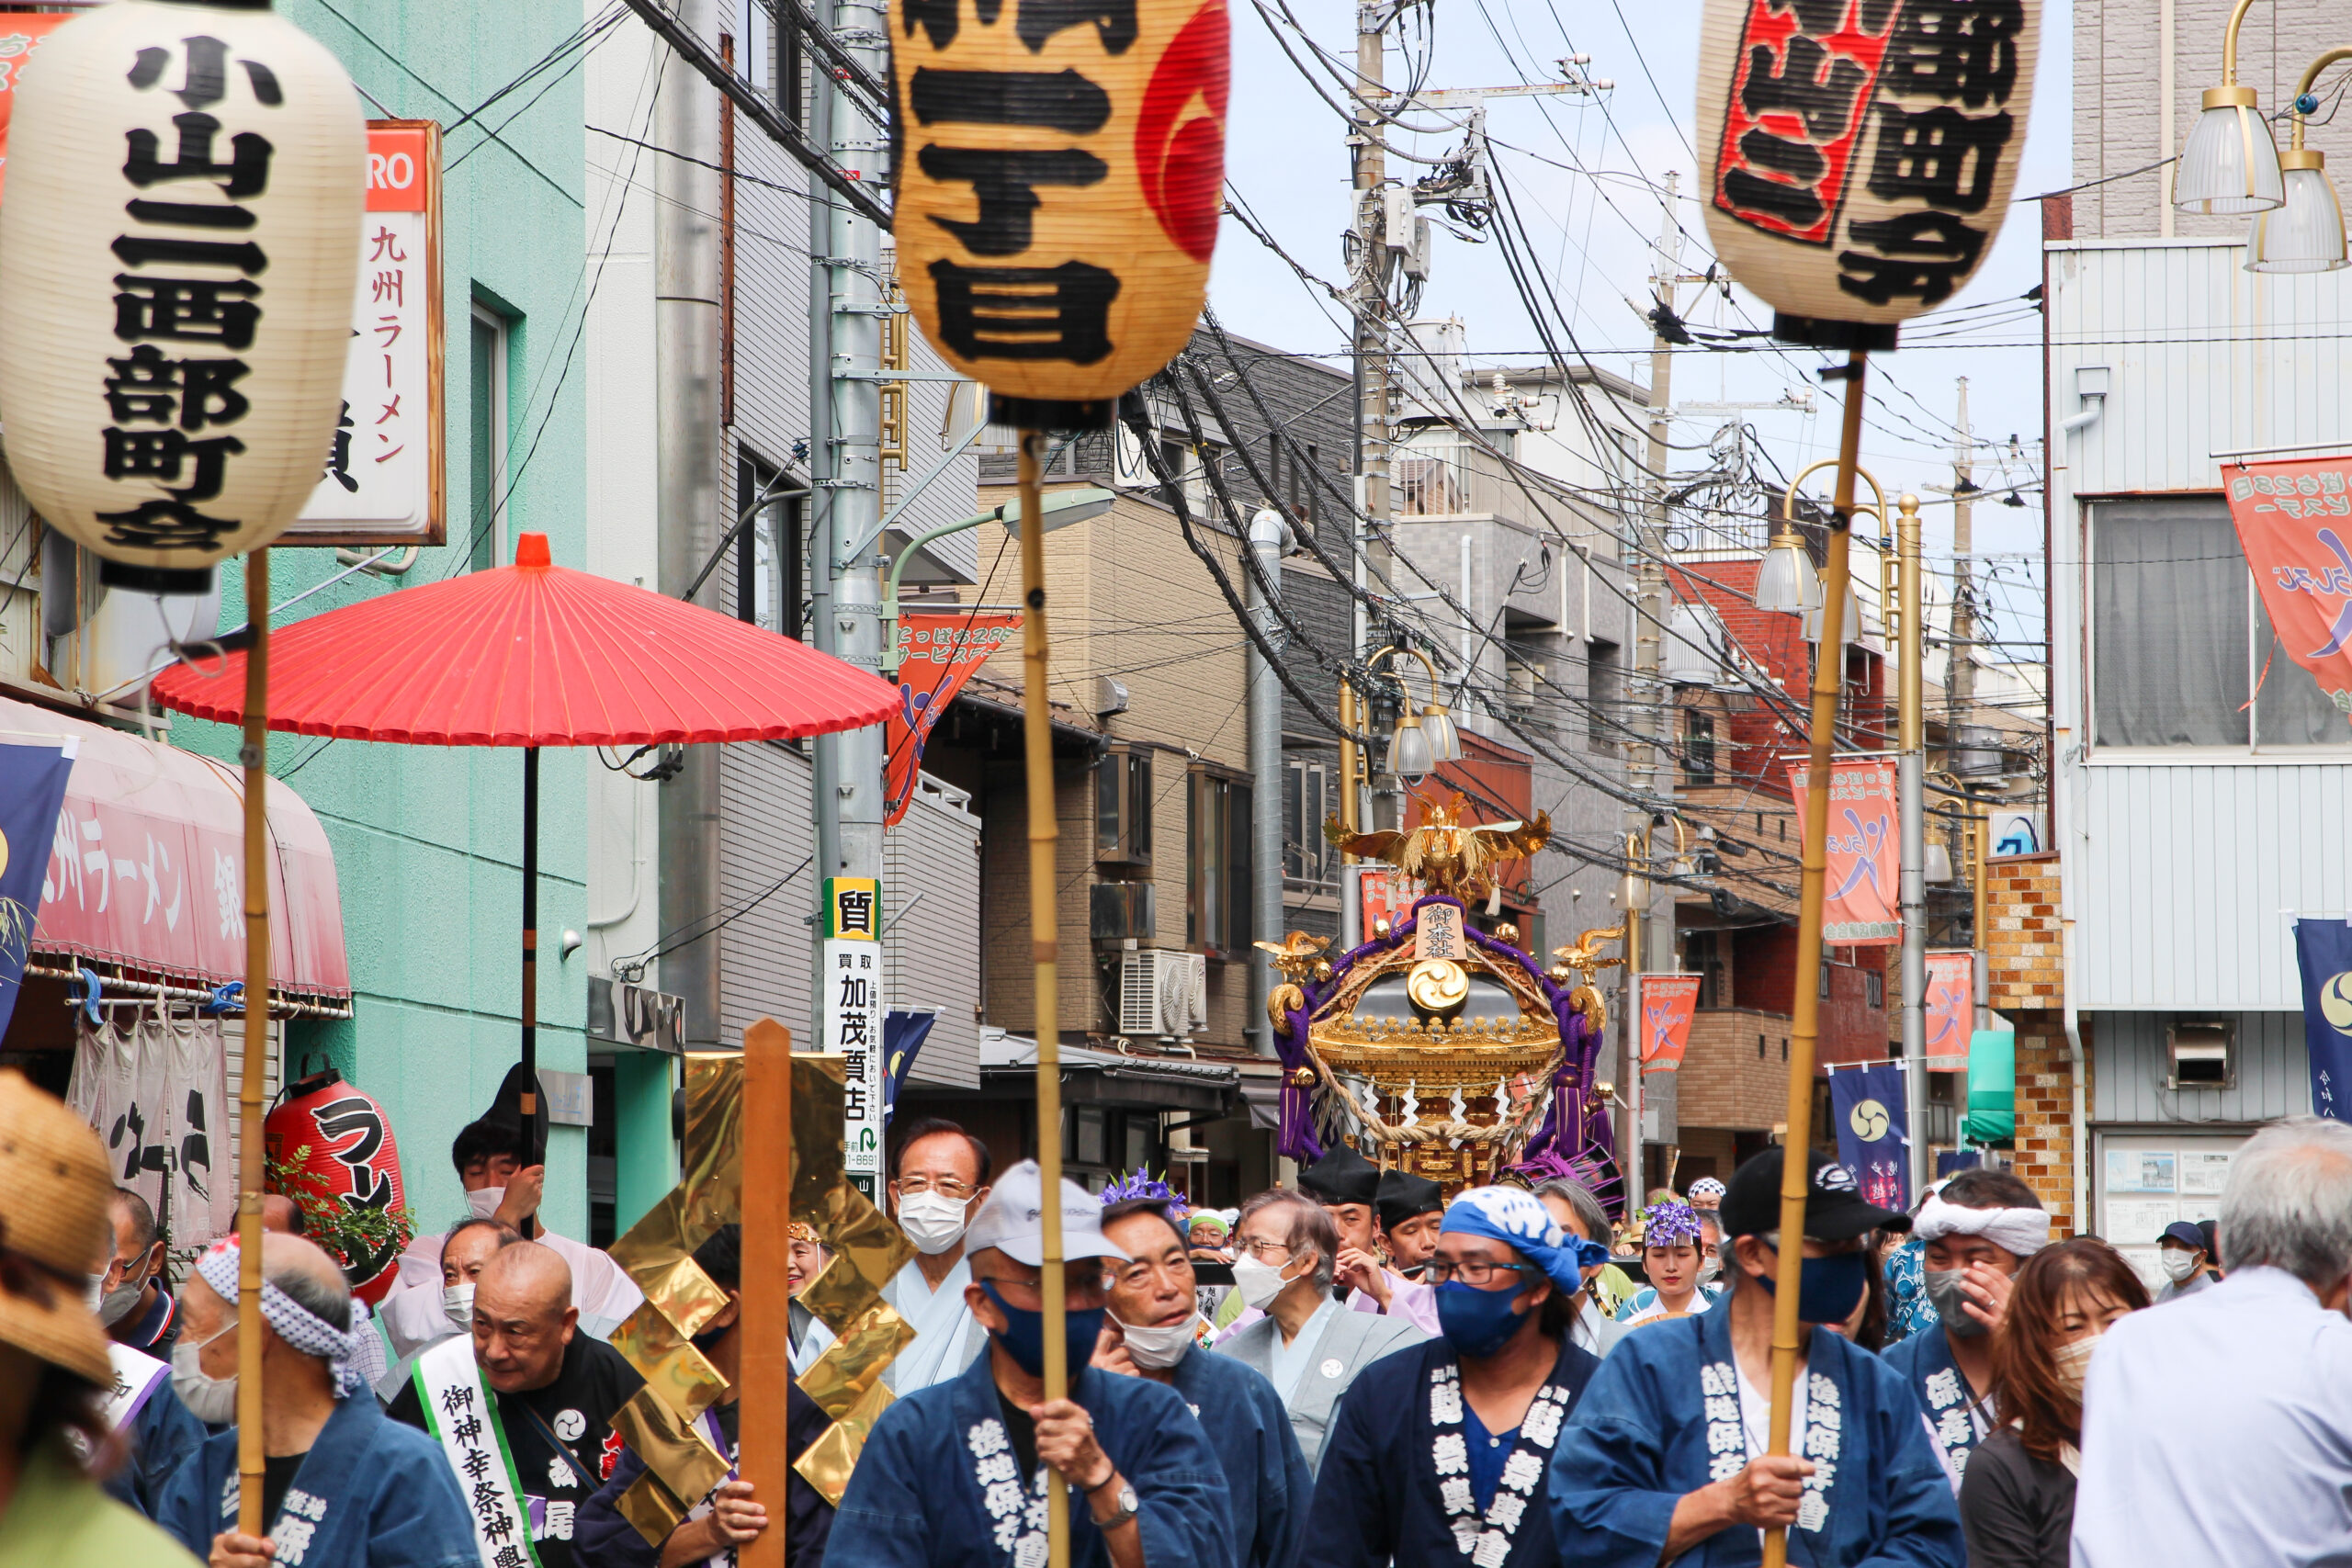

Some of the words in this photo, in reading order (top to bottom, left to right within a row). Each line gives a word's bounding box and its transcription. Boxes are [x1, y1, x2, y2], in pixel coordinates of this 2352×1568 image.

[369, 226, 408, 464] 九州ラーメン
[43, 807, 181, 934] 州ラーメン
[839, 888, 873, 935] 質
[839, 954, 872, 970] 買取
[1425, 905, 1454, 959] 御本社
[840, 975, 868, 1122] 加茂質店
